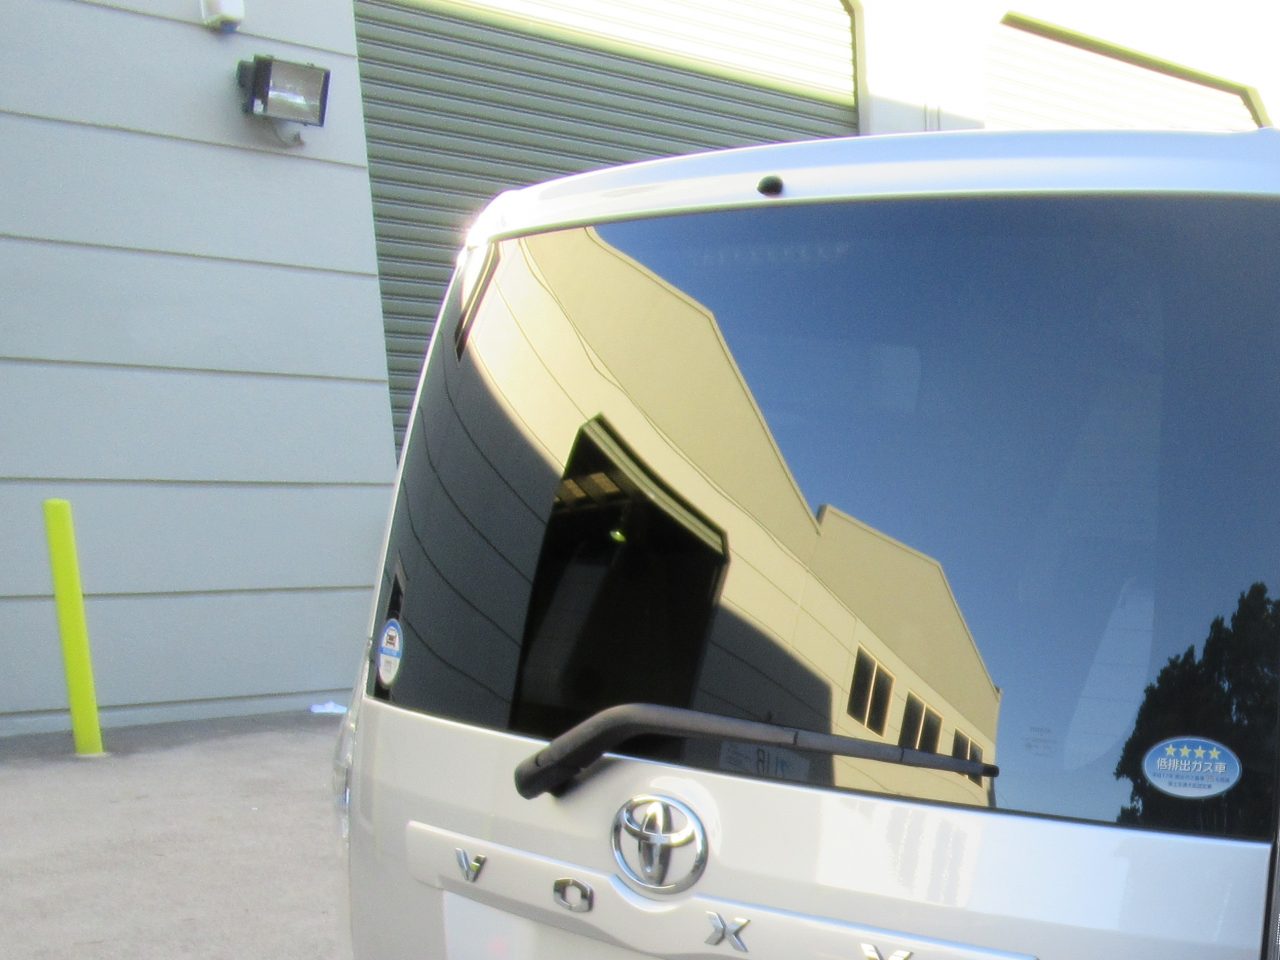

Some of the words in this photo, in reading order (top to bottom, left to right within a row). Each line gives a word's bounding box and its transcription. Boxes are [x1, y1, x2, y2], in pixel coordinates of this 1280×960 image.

[1156, 757, 1227, 774] 低排出ガス車
